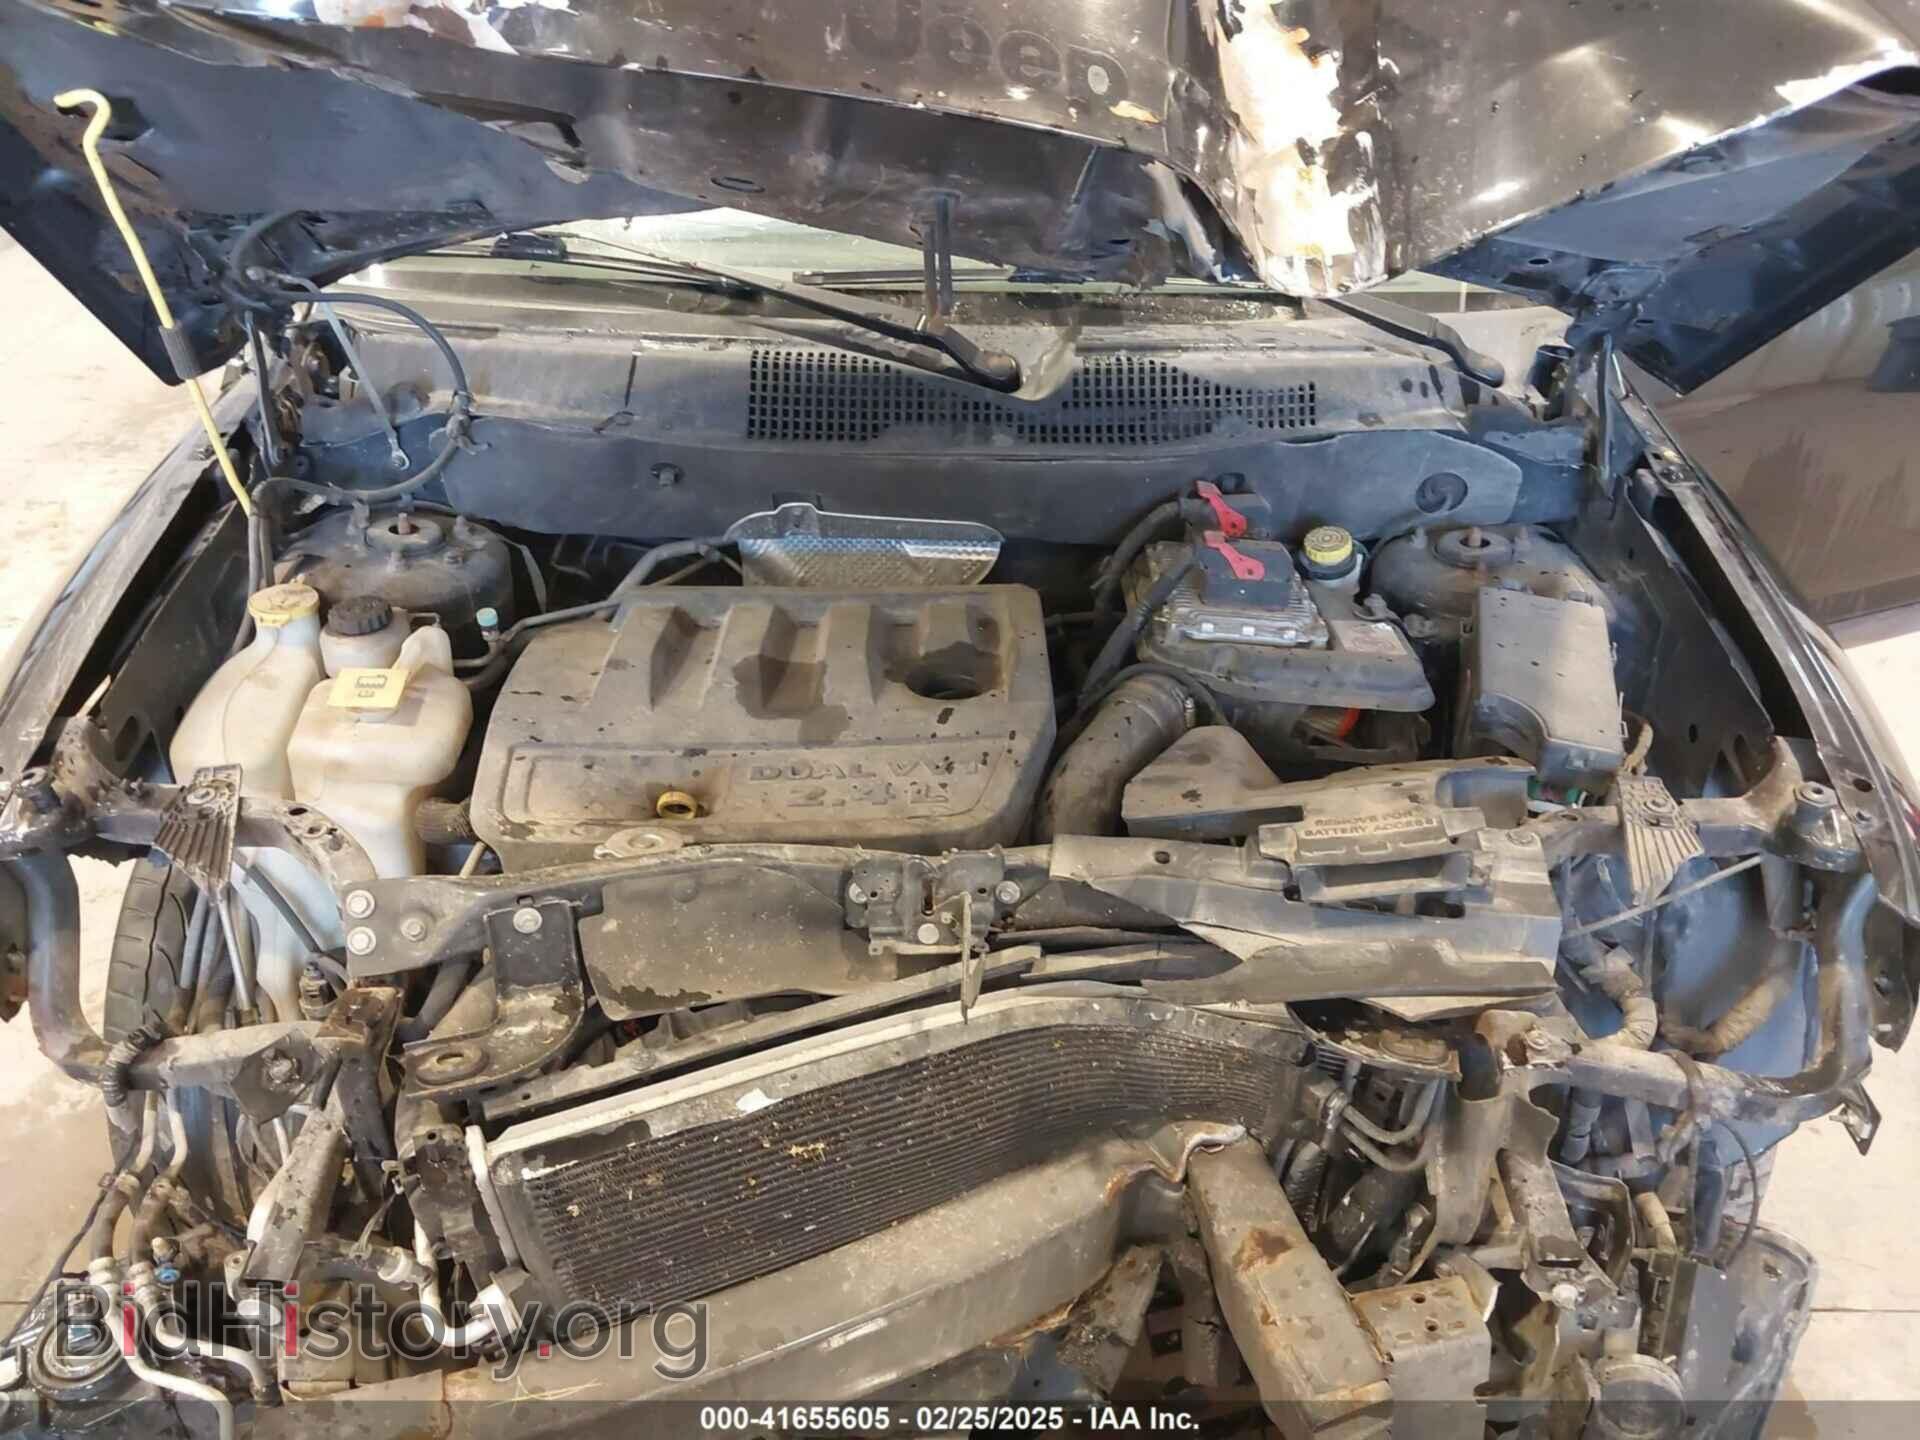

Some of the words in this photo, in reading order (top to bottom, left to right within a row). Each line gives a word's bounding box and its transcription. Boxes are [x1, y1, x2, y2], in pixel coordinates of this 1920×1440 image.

[844, 0, 1130, 113] Jeep
[750, 763, 877, 781] DUAL
[1304, 824, 1367, 837] BATTERY
[1374, 817, 1434, 831] ACCESS
[1314, 814, 1379, 827] REMOVE
[1382, 808, 1414, 821] FOR
